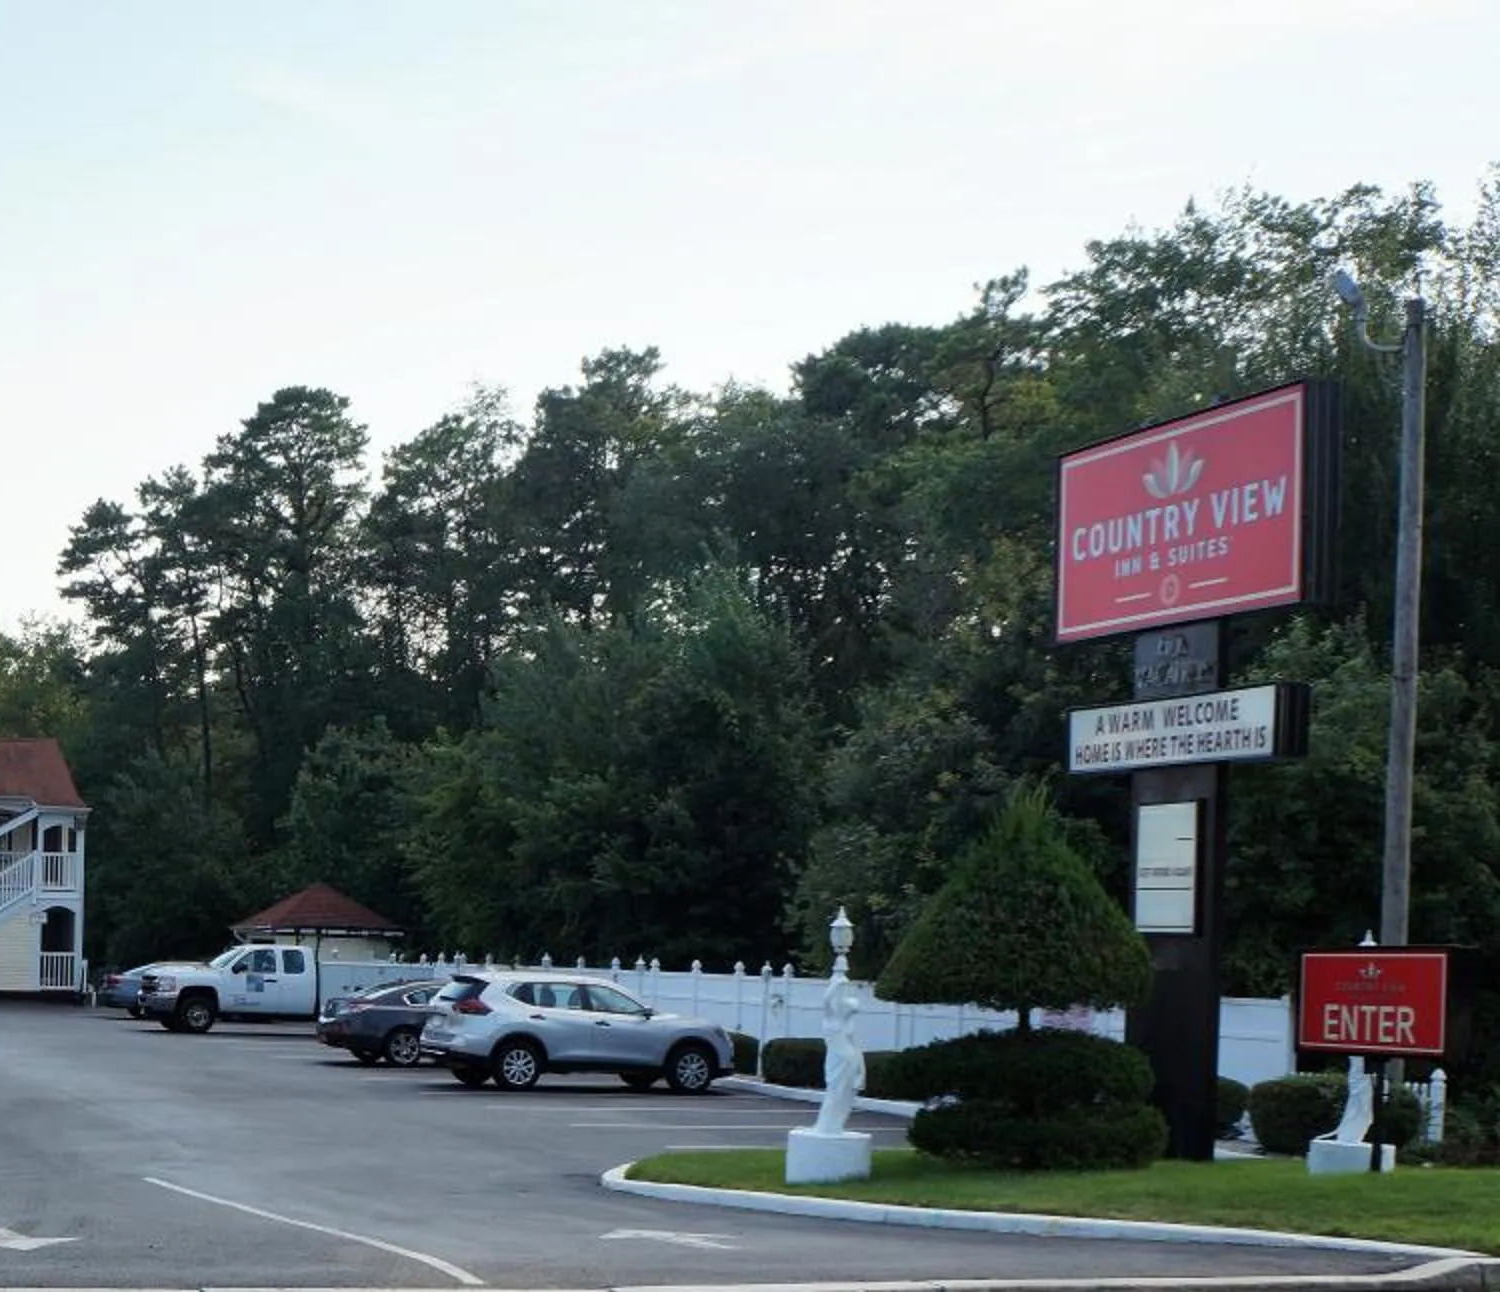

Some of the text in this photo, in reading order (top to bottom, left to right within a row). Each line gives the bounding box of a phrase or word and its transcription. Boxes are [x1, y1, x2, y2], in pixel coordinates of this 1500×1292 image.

[1072, 475, 1288, 562] COUNTRY VIEW
[1115, 536, 1229, 578] INN & SUITES
[1095, 698, 1239, 736] A WARM WELCOME
[1076, 724, 1267, 765] HOME IS WHERE THE HEARTH IS
[1323, 1003, 1416, 1045] ENTER
